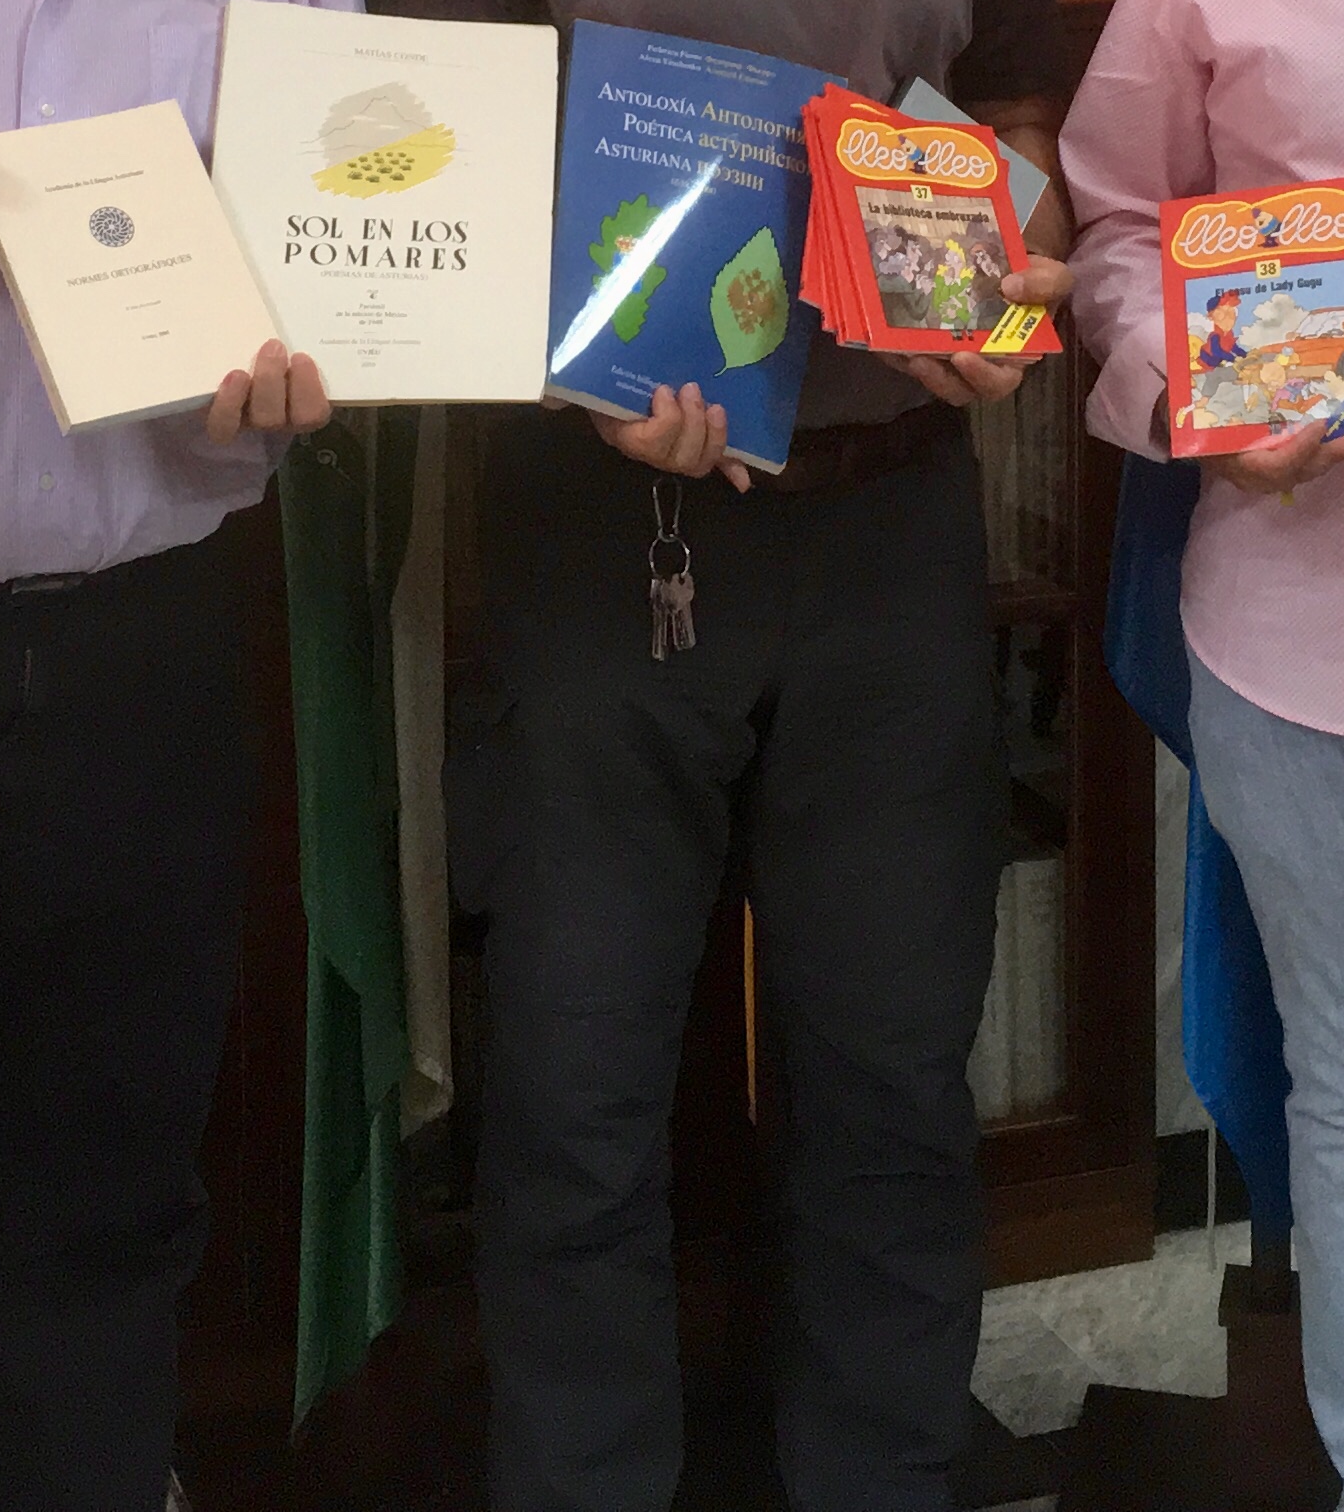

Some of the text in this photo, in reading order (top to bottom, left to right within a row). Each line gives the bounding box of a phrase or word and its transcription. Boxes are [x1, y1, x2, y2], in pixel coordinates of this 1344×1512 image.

[597, 81, 696, 117] ANTOLOXÍA
[623, 112, 694, 144] POÉTICA
[594, 136, 692, 173] ASTURIANA
[698, 132, 812, 176] астурийско
[914, 187, 928, 199] 37
[867, 202, 881, 214] La
[884, 204, 933, 219] biblioteca
[286, 214, 469, 244] SOL EN LOS
[284, 241, 468, 271] POMARES
[1259, 262, 1277, 276] 38
[67, 271, 110, 287] NORMES
[1254, 283, 1267, 294] de
[1270, 281, 1294, 293] Lady
